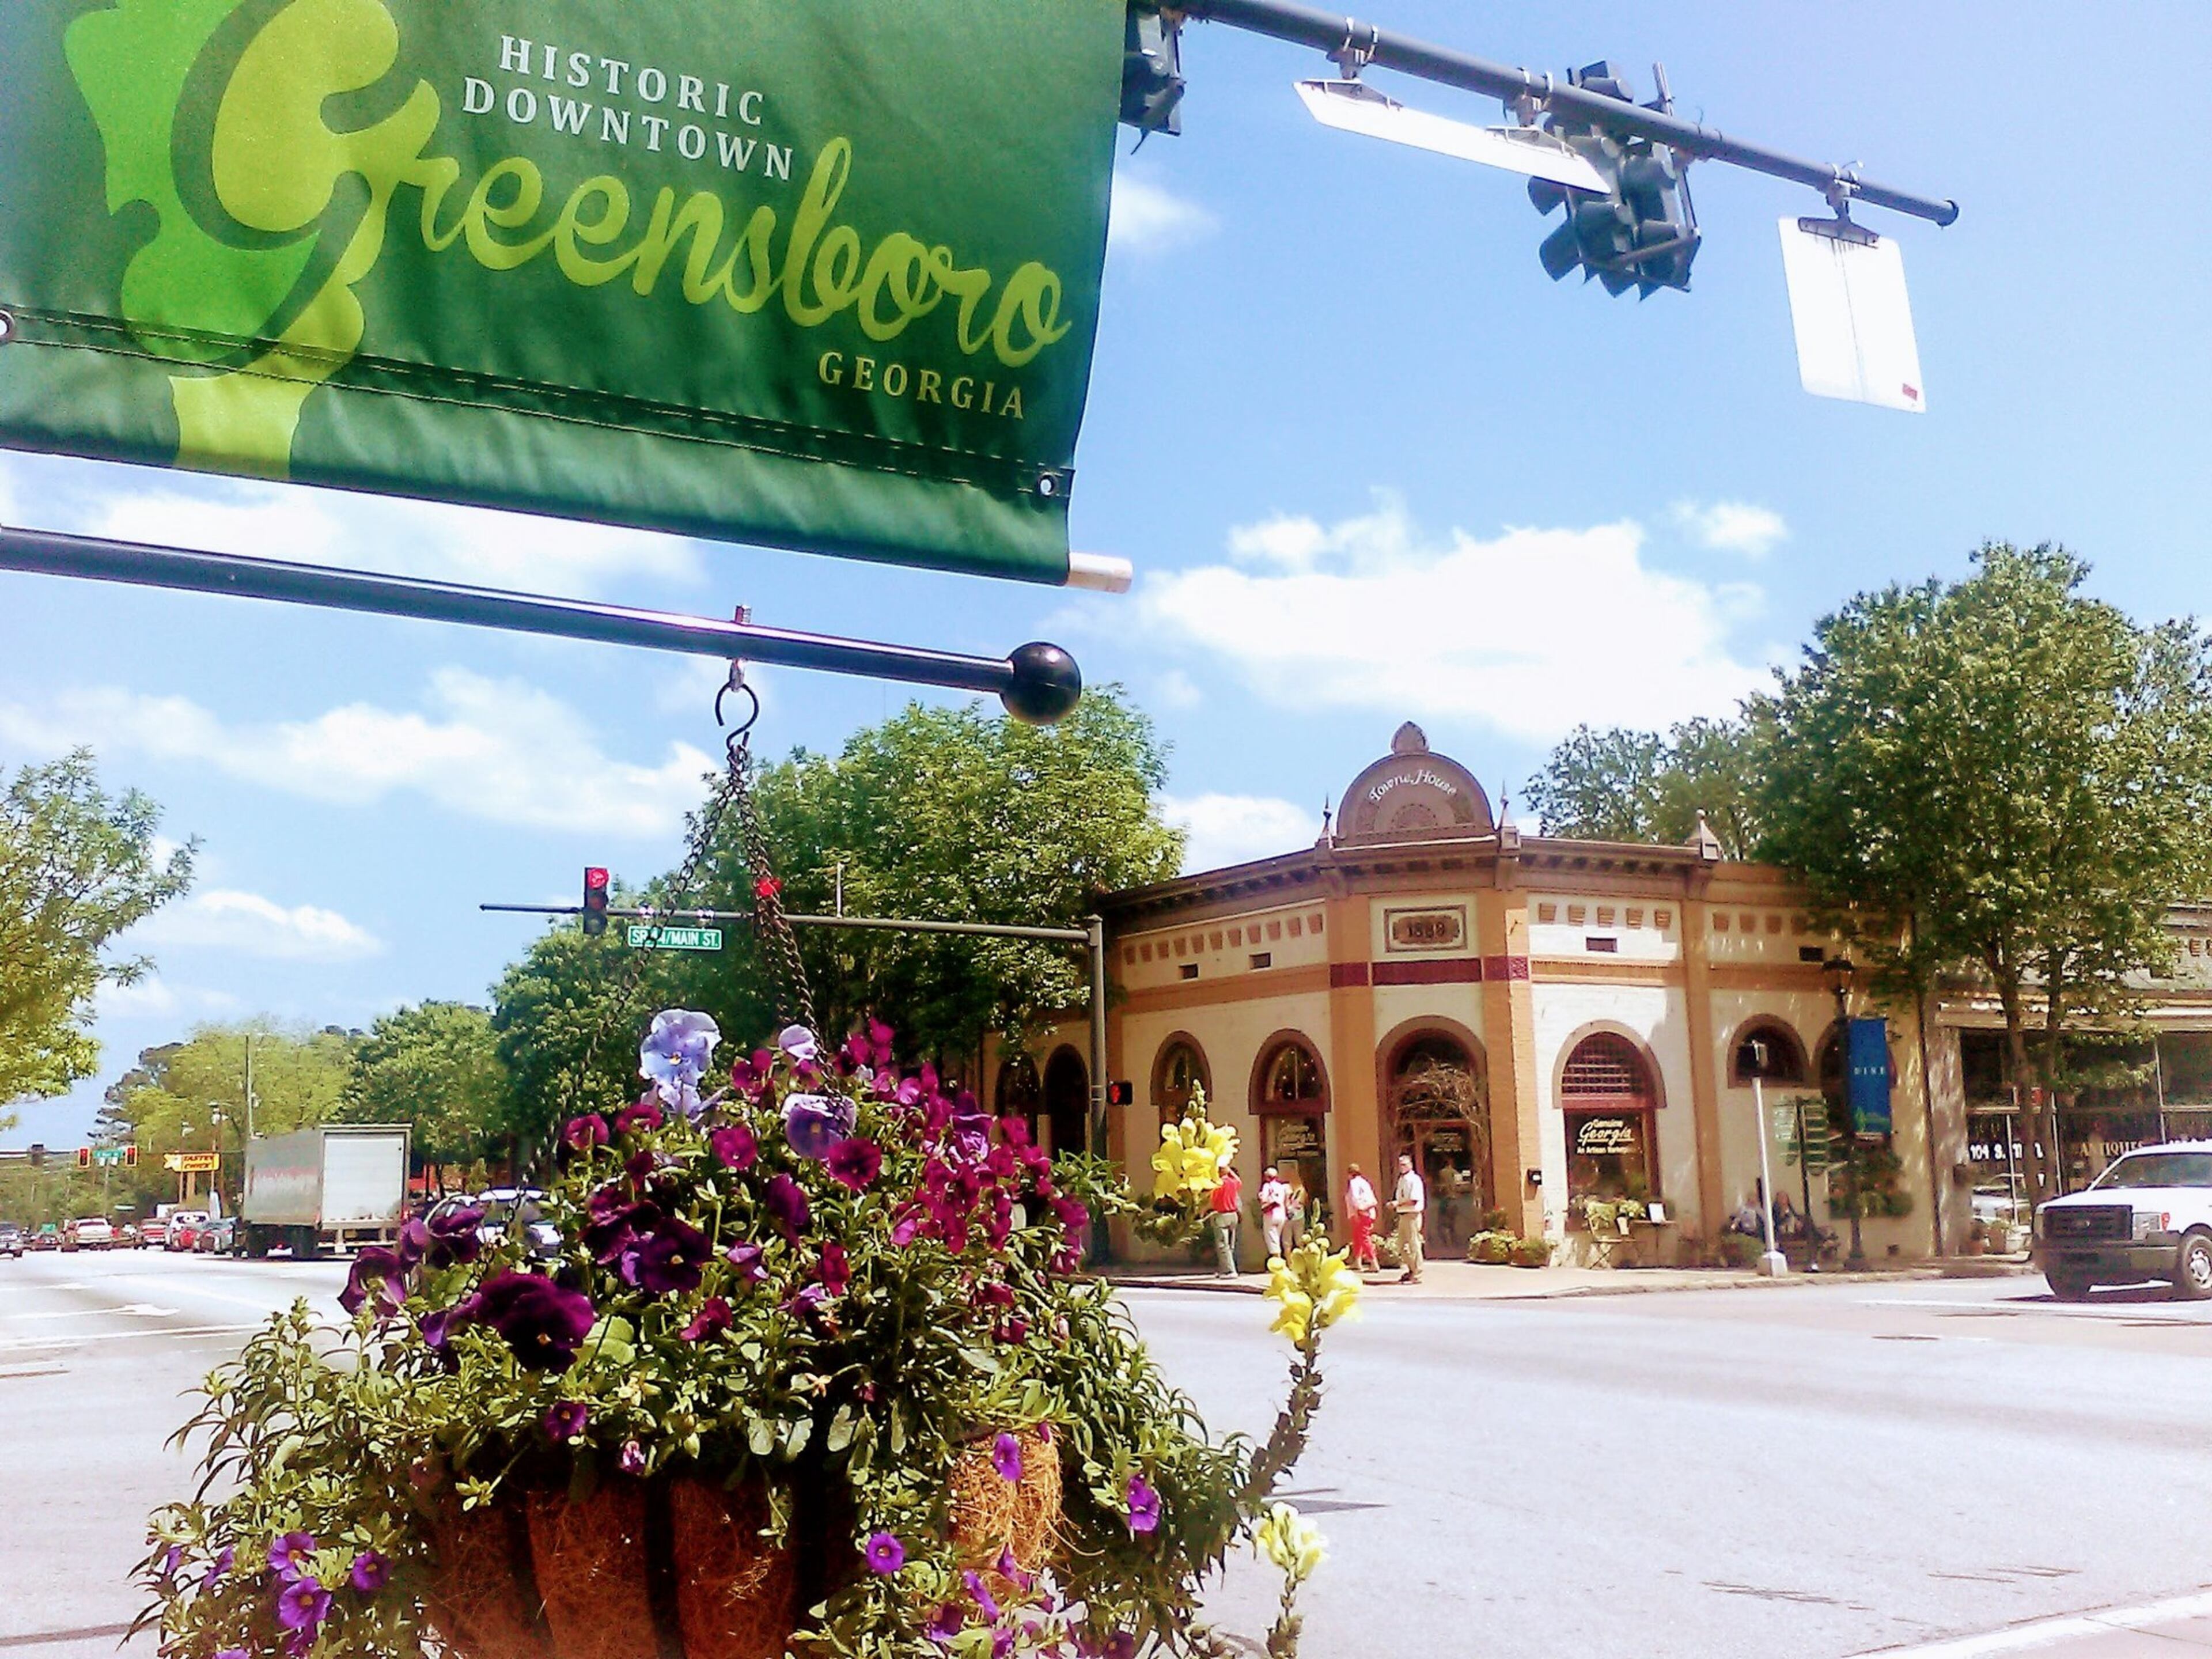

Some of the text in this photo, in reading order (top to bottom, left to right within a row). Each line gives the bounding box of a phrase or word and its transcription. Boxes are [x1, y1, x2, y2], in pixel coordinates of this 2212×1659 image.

[499, 35, 764, 126] HISTORIC
[463, 77, 793, 180] DOWNTOWN
[171, 0, 1072, 368] Greensboro
[819, 351, 1024, 421] GEORGIA
[1411, 769, 1457, 794] House
[702, 933, 719, 946] ST.
[1579, 1121, 1632, 1147] Georgia
